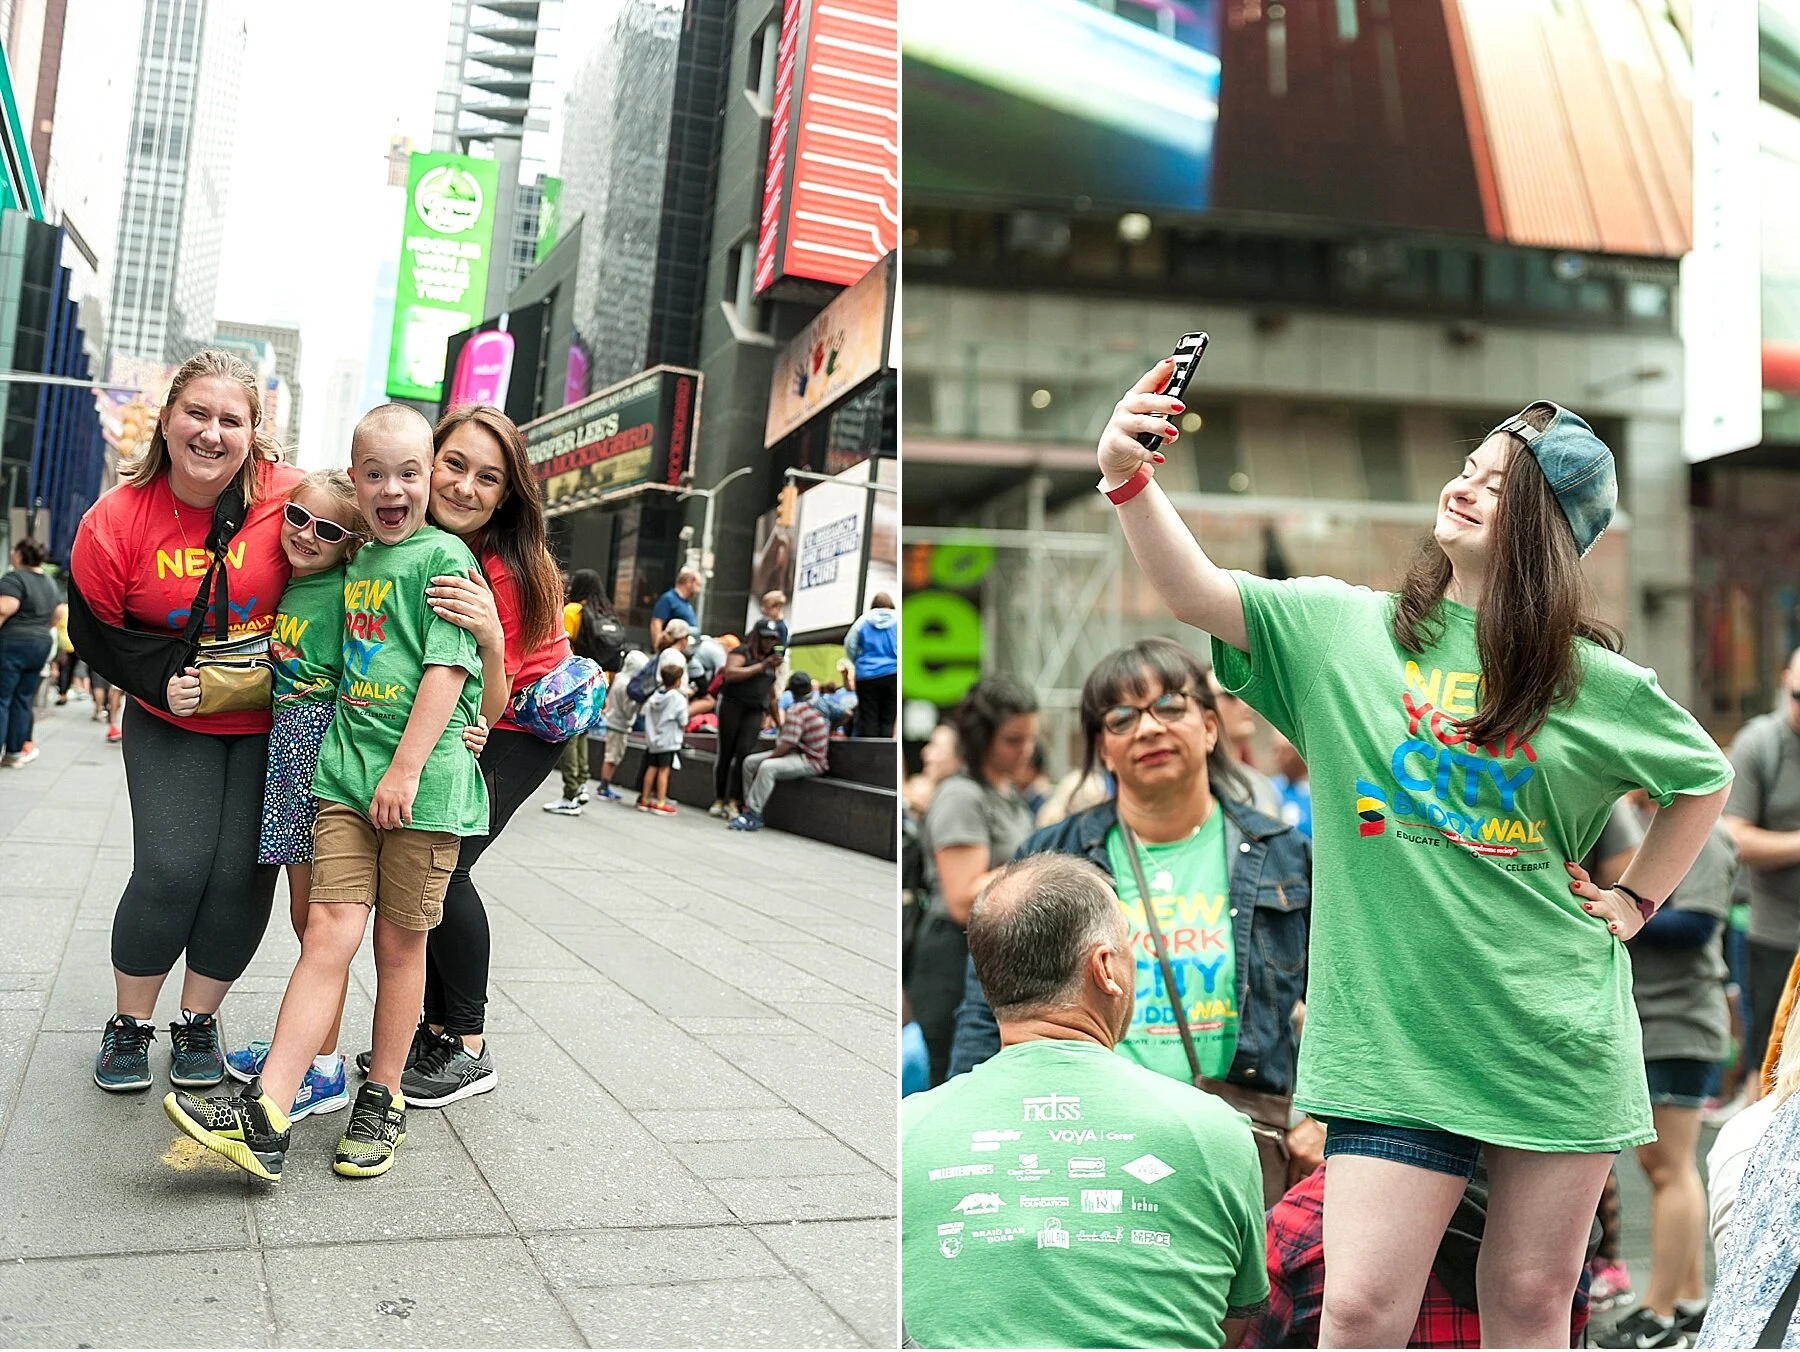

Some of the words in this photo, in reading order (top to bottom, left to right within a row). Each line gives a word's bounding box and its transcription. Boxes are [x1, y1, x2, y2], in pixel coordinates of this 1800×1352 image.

[1391, 738, 1535, 812] CITY
[1396, 830, 1440, 847] EDUCATE
[1505, 861, 1550, 872] CELEBRATE
